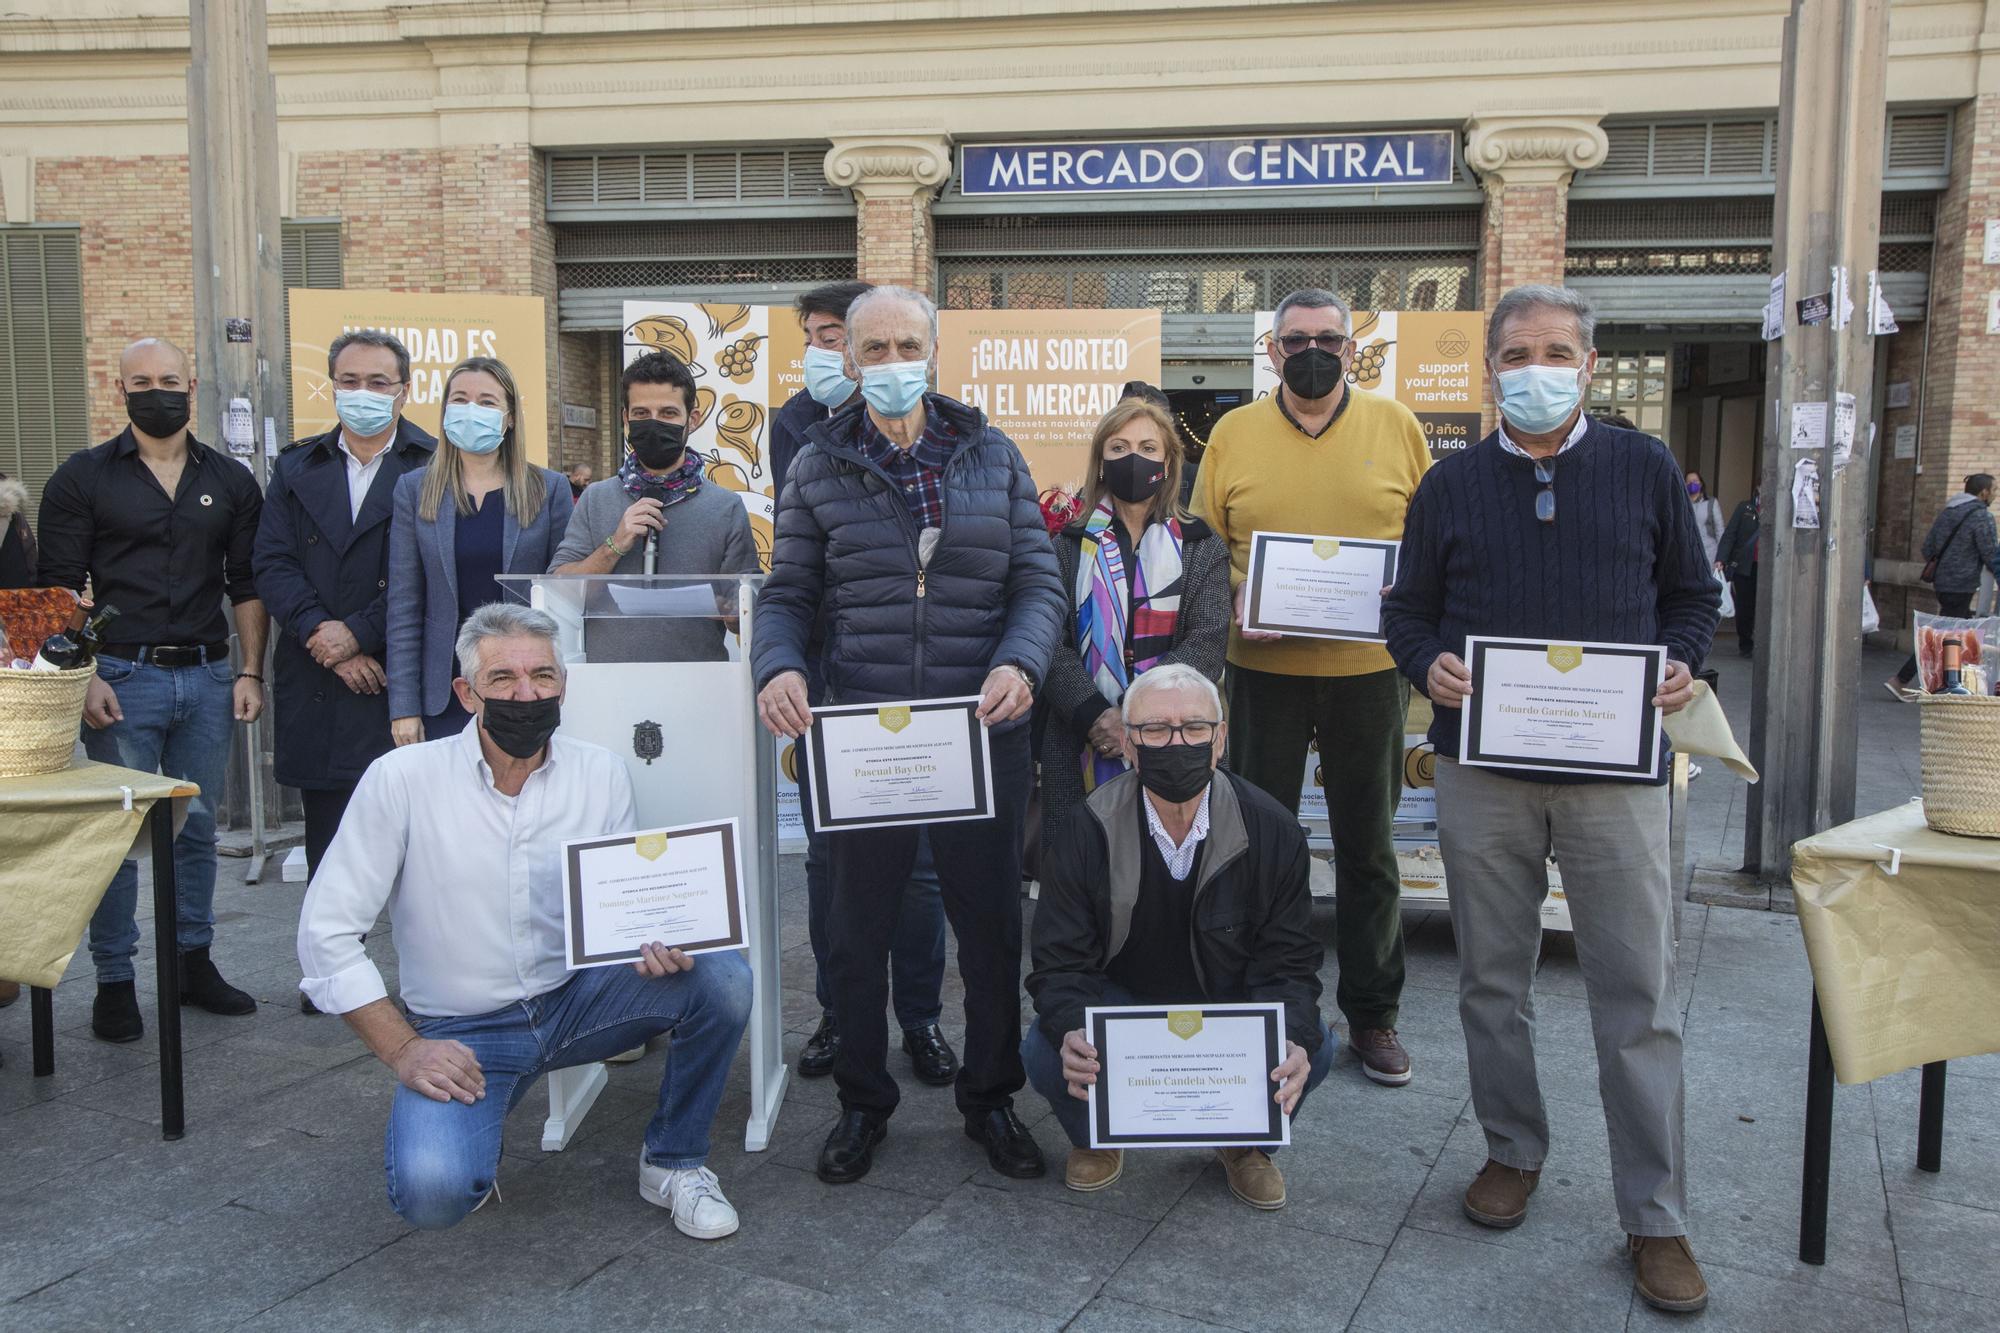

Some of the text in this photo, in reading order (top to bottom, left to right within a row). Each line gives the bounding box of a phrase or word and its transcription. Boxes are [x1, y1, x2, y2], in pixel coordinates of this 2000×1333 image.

[988, 140, 1424, 187] MERCADO CENTRAL
[971, 338, 1128, 378] ¡GRAN SORTEO
[1418, 362, 1470, 375] support
[1405, 376, 1469, 390] your local
[996, 384, 1020, 416] EL
[1027, 383, 1125, 416] MERCAD
[1415, 390, 1469, 401] markets
[1436, 423, 1467, 435] años
[1033, 432, 1046, 440] de
[1049, 432, 1064, 440] los
[1438, 437, 1467, 449] lado
[1498, 703, 1616, 720] Eduardo Garrido Martín
[854, 763, 937, 777] Pascual Bay Orts
[1128, 1075, 1247, 1087] Emilio Candela Novella
